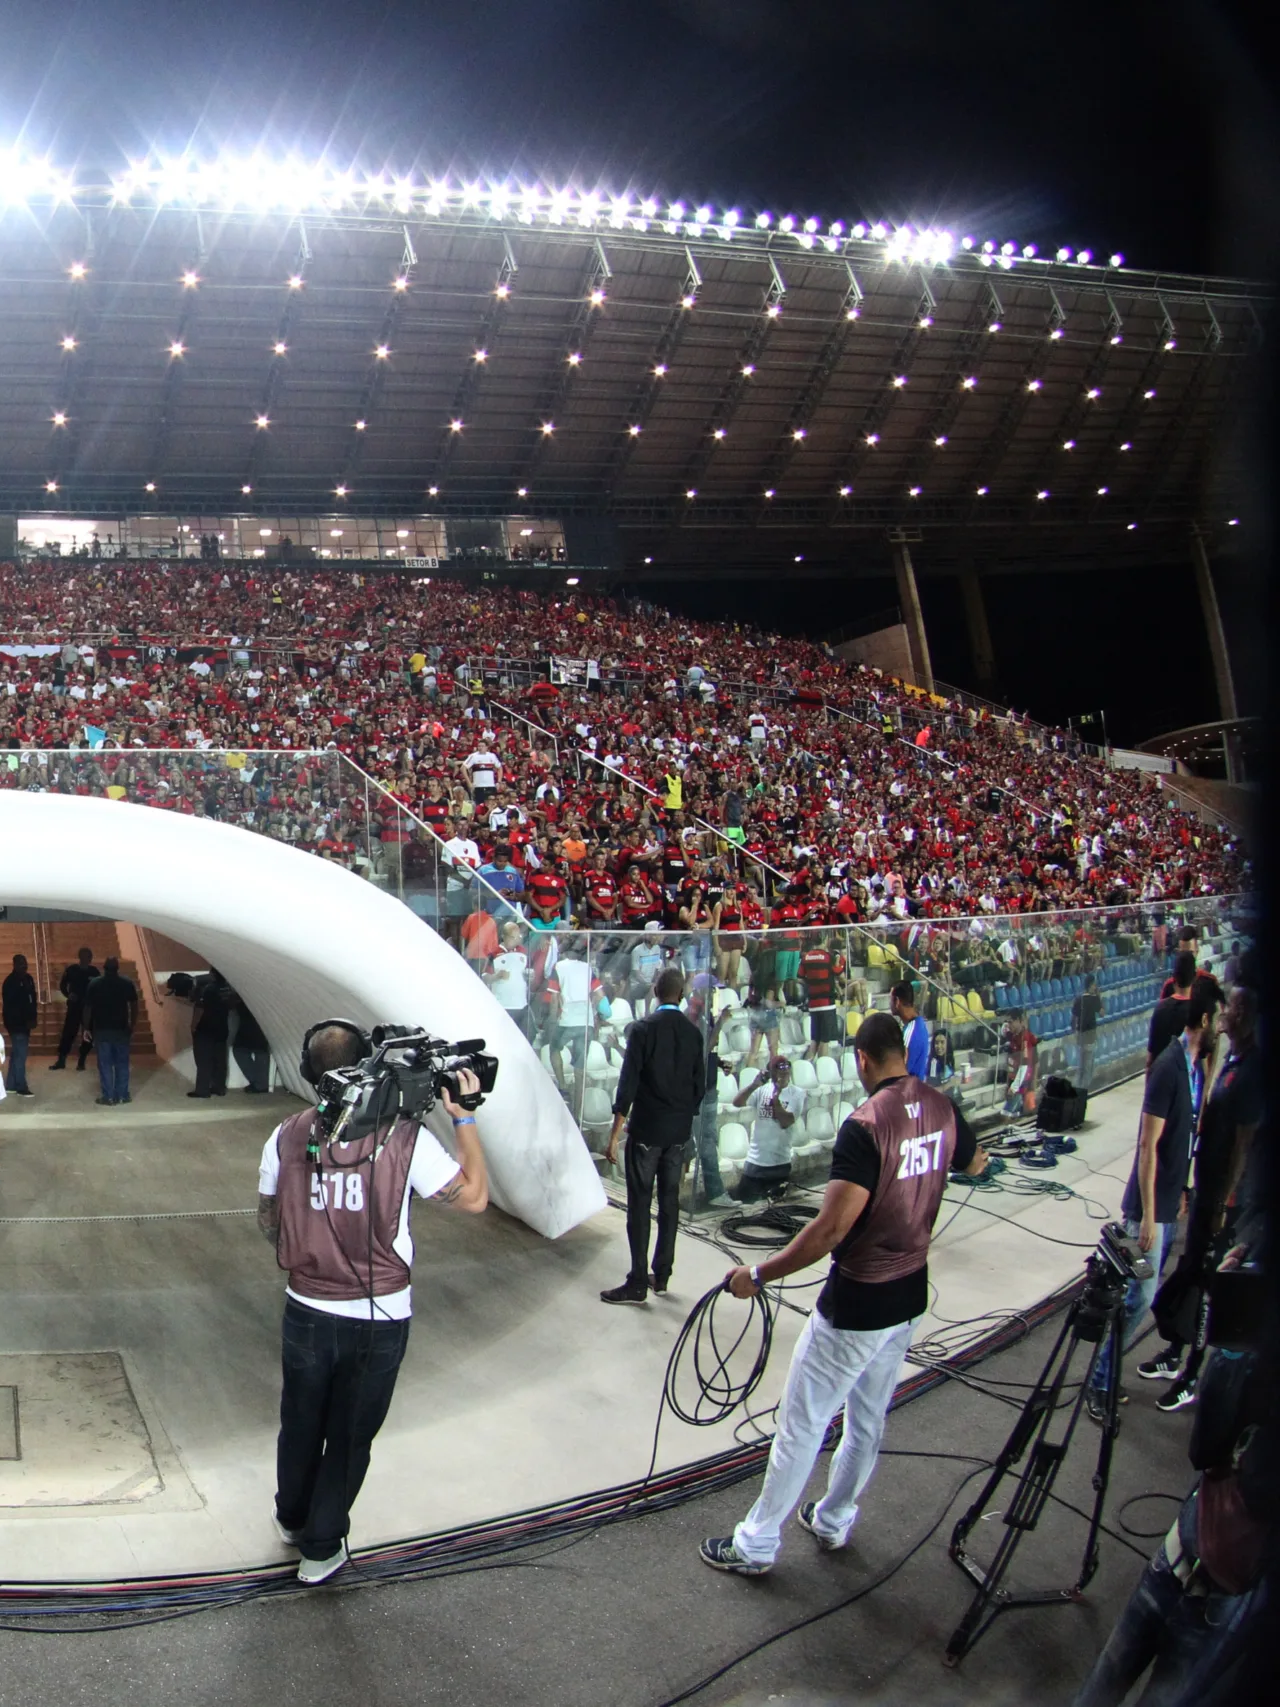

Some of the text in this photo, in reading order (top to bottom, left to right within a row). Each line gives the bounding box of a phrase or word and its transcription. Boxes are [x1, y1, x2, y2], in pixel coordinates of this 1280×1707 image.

[406, 558, 437, 567] SETOR B
[904, 1101, 922, 1119] TV
[897, 1130, 944, 1180] 2157
[310, 1171, 364, 1212] 518
